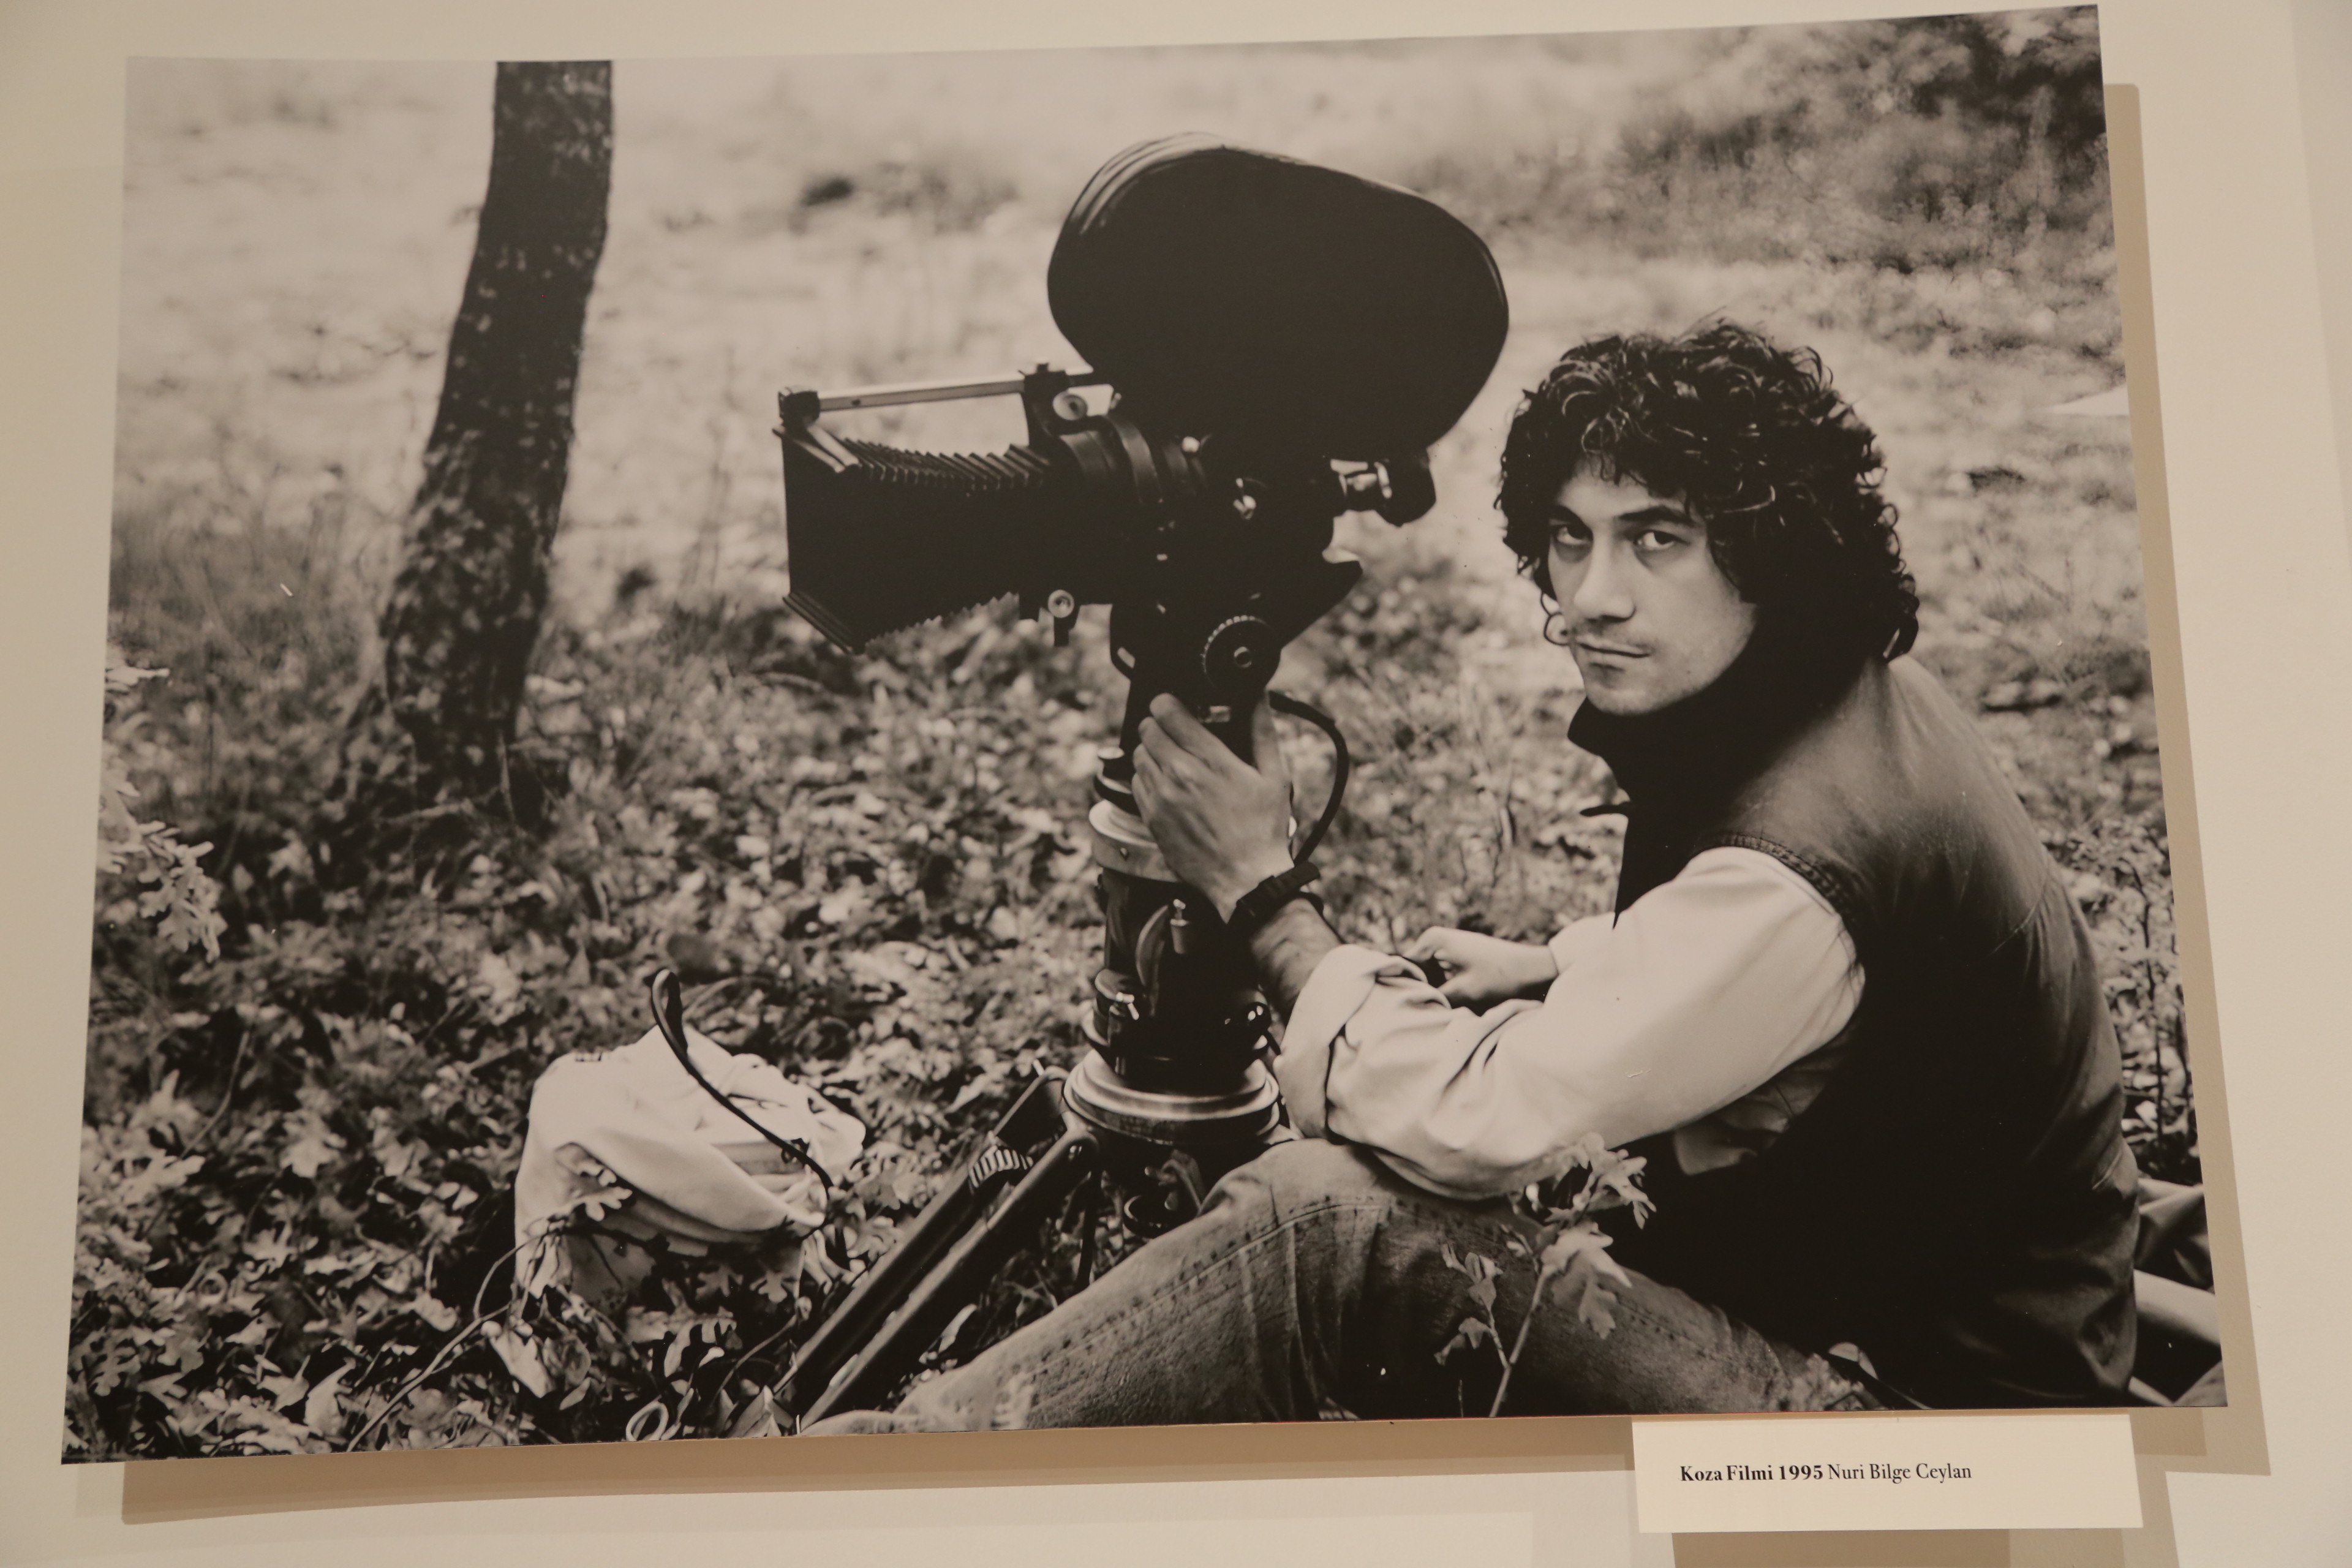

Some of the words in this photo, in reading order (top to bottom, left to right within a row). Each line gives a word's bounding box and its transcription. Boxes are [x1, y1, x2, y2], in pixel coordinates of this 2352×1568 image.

[1679, 1465, 1723, 1481] Koza
[1726, 1464, 1773, 1480] Filmi
[1779, 1464, 1823, 1480] 1995
[1827, 1464, 1864, 1479] Nuri
[1869, 1463, 1910, 1483] Bilge
[1915, 1463, 1972, 1483] Ceylan
